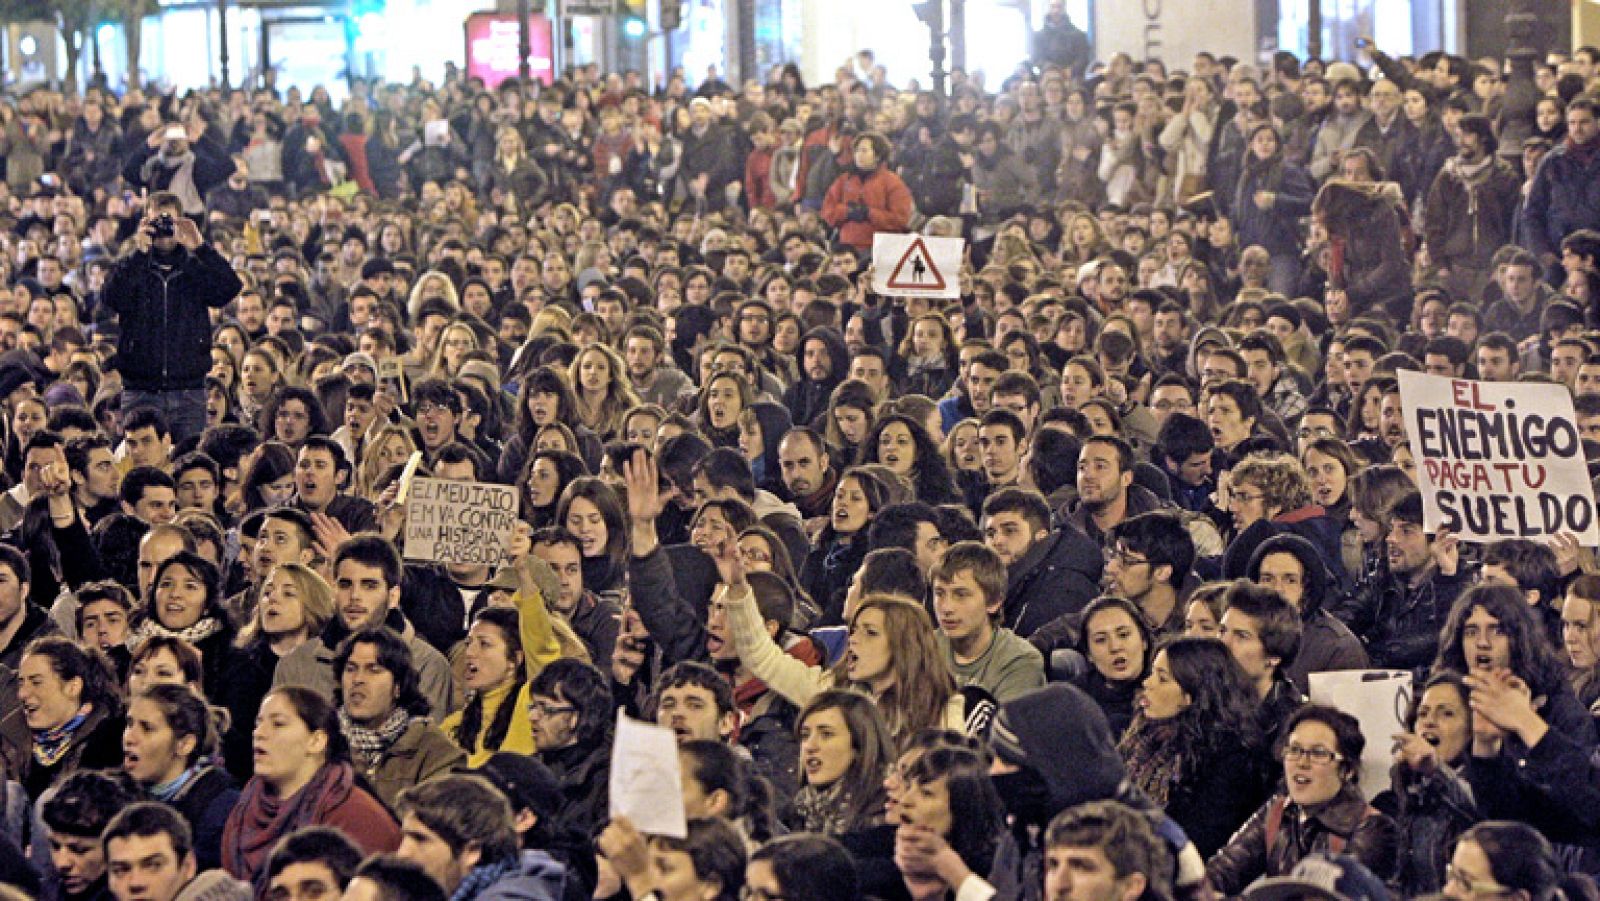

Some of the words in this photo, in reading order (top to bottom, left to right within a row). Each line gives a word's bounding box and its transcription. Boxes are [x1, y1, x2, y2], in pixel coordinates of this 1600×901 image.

[1451, 380, 1496, 412] EL
[1423, 459, 1492, 492] PAGA
[1493, 463, 1547, 491] TU
[412, 481, 432, 499] EL
[435, 484, 469, 503] MEU
[410, 503, 434, 523] EM
[439, 504, 455, 523] VA
[458, 507, 516, 531] CONTAR
[1436, 490, 1592, 536] SUELDO
[408, 527, 433, 539] UNA
